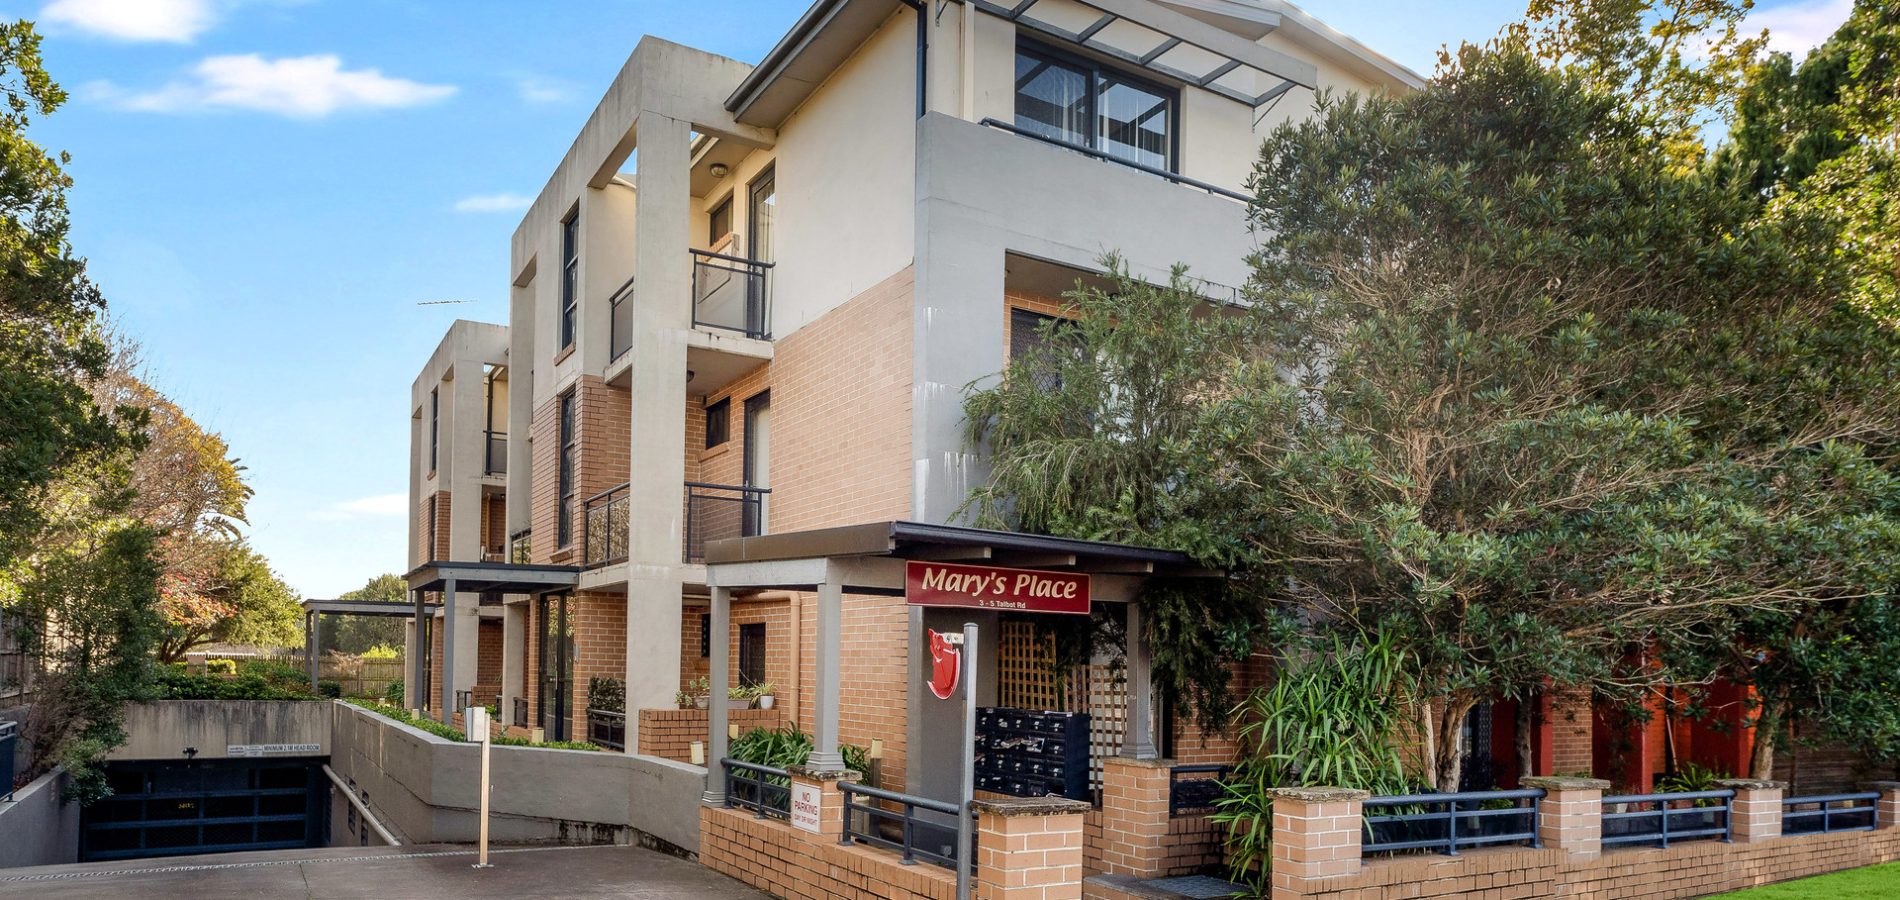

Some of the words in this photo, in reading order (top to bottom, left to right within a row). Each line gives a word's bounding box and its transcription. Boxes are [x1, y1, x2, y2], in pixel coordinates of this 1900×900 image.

[921, 567, 1007, 597] Mary's
[1013, 574, 1077, 599] Place
[996, 600, 1016, 608] Talbot
[1016, 601, 1026, 609] Rd
[802, 792, 810, 802] NO
[794, 801, 818, 815] PARKING
